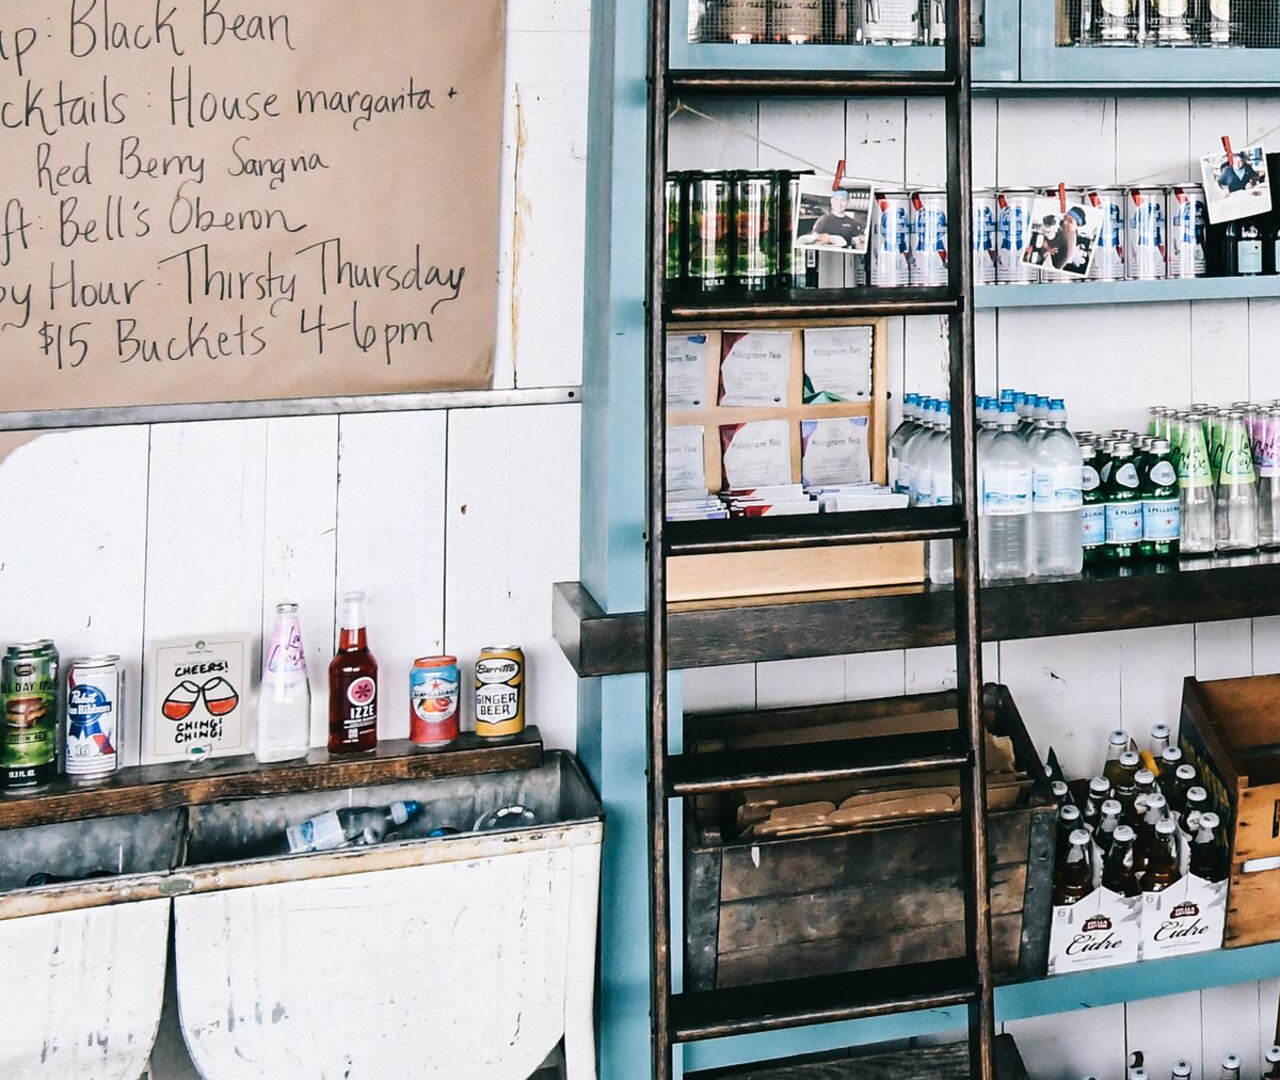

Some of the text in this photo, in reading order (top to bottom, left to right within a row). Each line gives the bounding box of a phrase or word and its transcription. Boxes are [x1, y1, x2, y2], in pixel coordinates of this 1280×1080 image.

[169, 65, 281, 129] House
[297, 77, 433, 131] margarita
[36, 136, 329, 195] Red Berry Sangria
[60, 195, 151, 247] Bell's
[169, 180, 308, 235] Oberon
[158, 244, 296, 318] Thirsty
[296, 237, 466, 314] Thursday
[38, 321, 89, 369] $15
[117, 316, 267, 364] Buckets
[174, 661, 229, 677] CHEERS!
[15, 682, 35, 693] DAY
[476, 693, 516, 705] GINGER
[350, 703, 375, 719] IZZE
[480, 704, 511, 716] BEER
[176, 718, 222, 732] CHING!
[174, 728, 222, 743] CHING!
[1153, 918, 1209, 942] Cidre
[1065, 932, 1122, 956] Cidre
